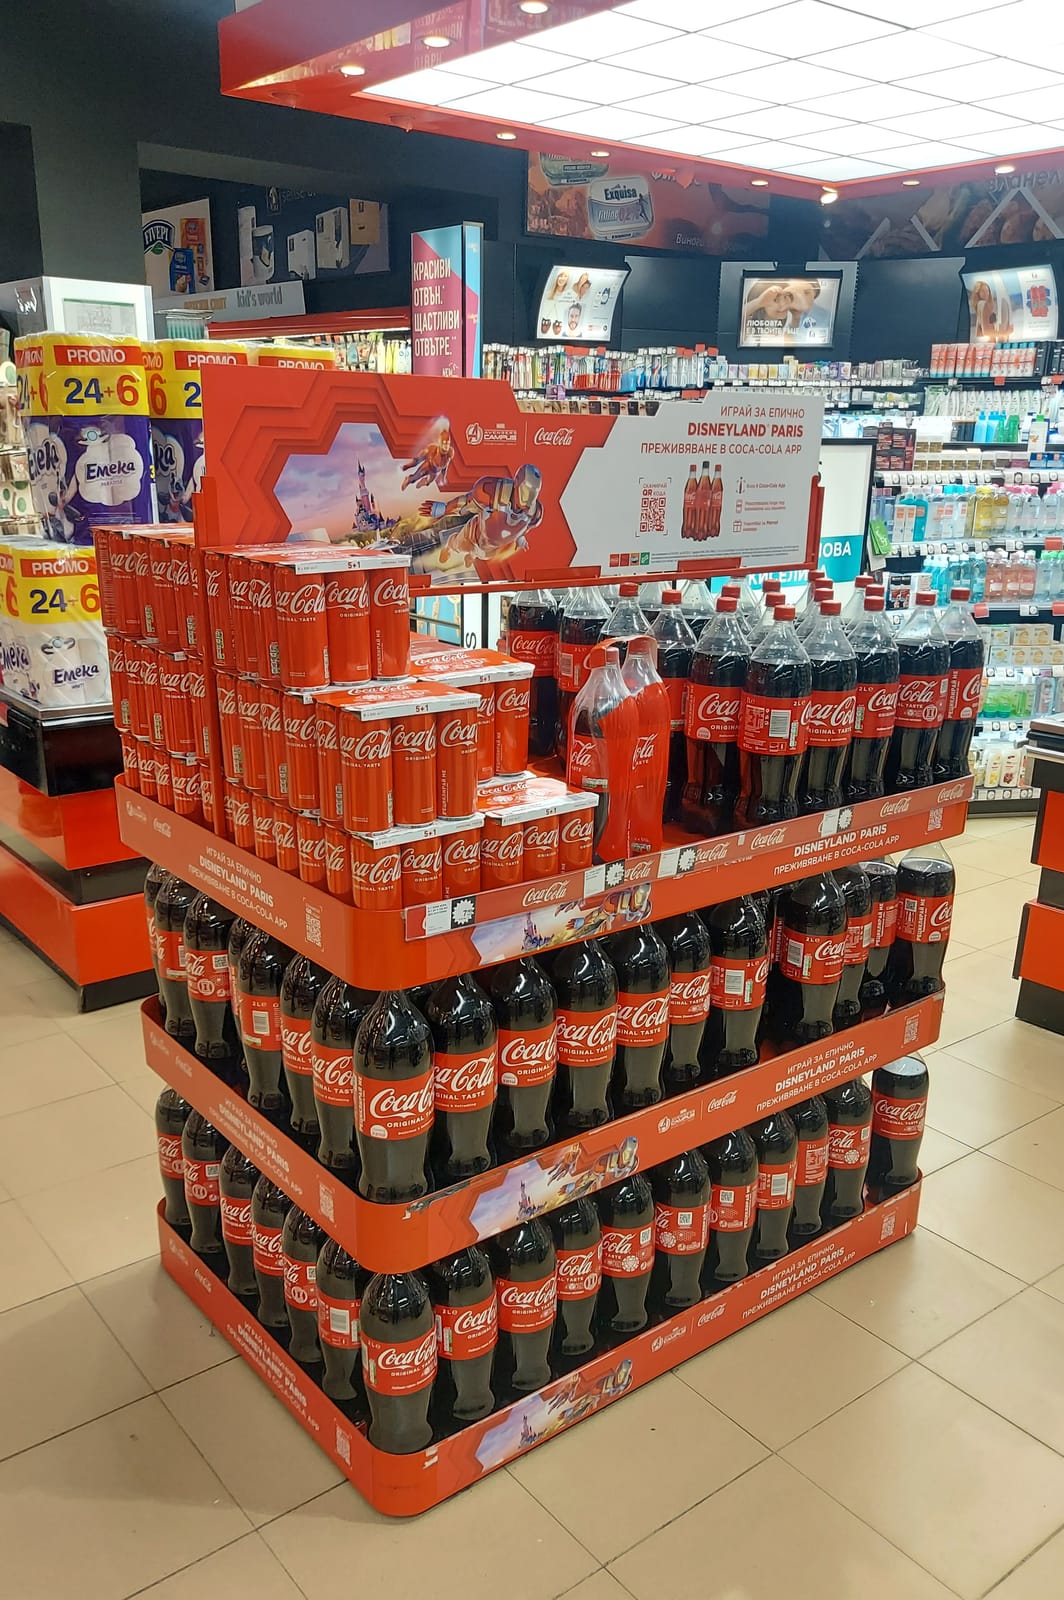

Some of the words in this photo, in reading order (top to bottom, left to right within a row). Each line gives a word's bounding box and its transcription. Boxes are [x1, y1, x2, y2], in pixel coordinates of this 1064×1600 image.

[604, 187, 638, 201] Exquisa
[413, 257, 451, 282] КРАСИВИ
[237, 288, 257, 307] kid's
[259, 286, 282, 306] world
[414, 310, 460, 334] ЩАСТЛИВИ
[67, 349, 126, 363] PROMO
[720, 405, 753, 417] ИГРАЙ
[755, 407, 766, 417] ЗА
[769, 408, 805, 419] ЕПИЧНО
[688, 423, 766, 437] DISNEYLAND
[771, 425, 803, 437] PARIS
[640, 443, 717, 455] ПРЕЖИВЯВАНЕ
[728, 444, 782, 455] COCA-COLA
[785, 445, 802, 454] APP
[86, 460, 136, 480] Emeka
[820, 541, 852, 558] ОВА
[31, 560, 90, 575] PROMO
[793, 831, 856, 858] DISNEYLAND
[859, 824, 888, 839] PARIS
[773, 855, 833, 876] ПРЕЖИВЯВАНЕ
[841, 840, 885, 857] COCA-COLA
[200, 855, 248, 891] DISNEYLAND
[250, 885, 274, 907] PARIS
[640, 1028, 661, 1036] TASTE
[787, 1058, 813, 1075] ИГРАЙ
[813, 1053, 824, 1064] ЗА
[825, 1041, 854, 1060] ЕПИЧНО
[517, 1065, 550, 1075] ORIGINAL
[775, 1059, 836, 1093] DISNEYLAND
[839, 1047, 865, 1065] PARIS
[756, 1081, 813, 1112] ПРЕЖИВЯВАНЕ
[821, 1061, 863, 1084] COCA-COLA
[864, 1054, 878, 1067] APP
[461, 1090, 486, 1100] TASTE
[387, 1115, 424, 1128] ORIGINAL
[772, 1263, 796, 1282] ИГРАЙ
[797, 1260, 807, 1269] ЗА
[808, 1243, 835, 1263] ЕПИЧНО
[760, 1262, 817, 1299] DISNEYLAND
[820, 1247, 845, 1267] PARIS
[742, 1286, 796, 1319] ПРЕЖИВЯВАНЕ
